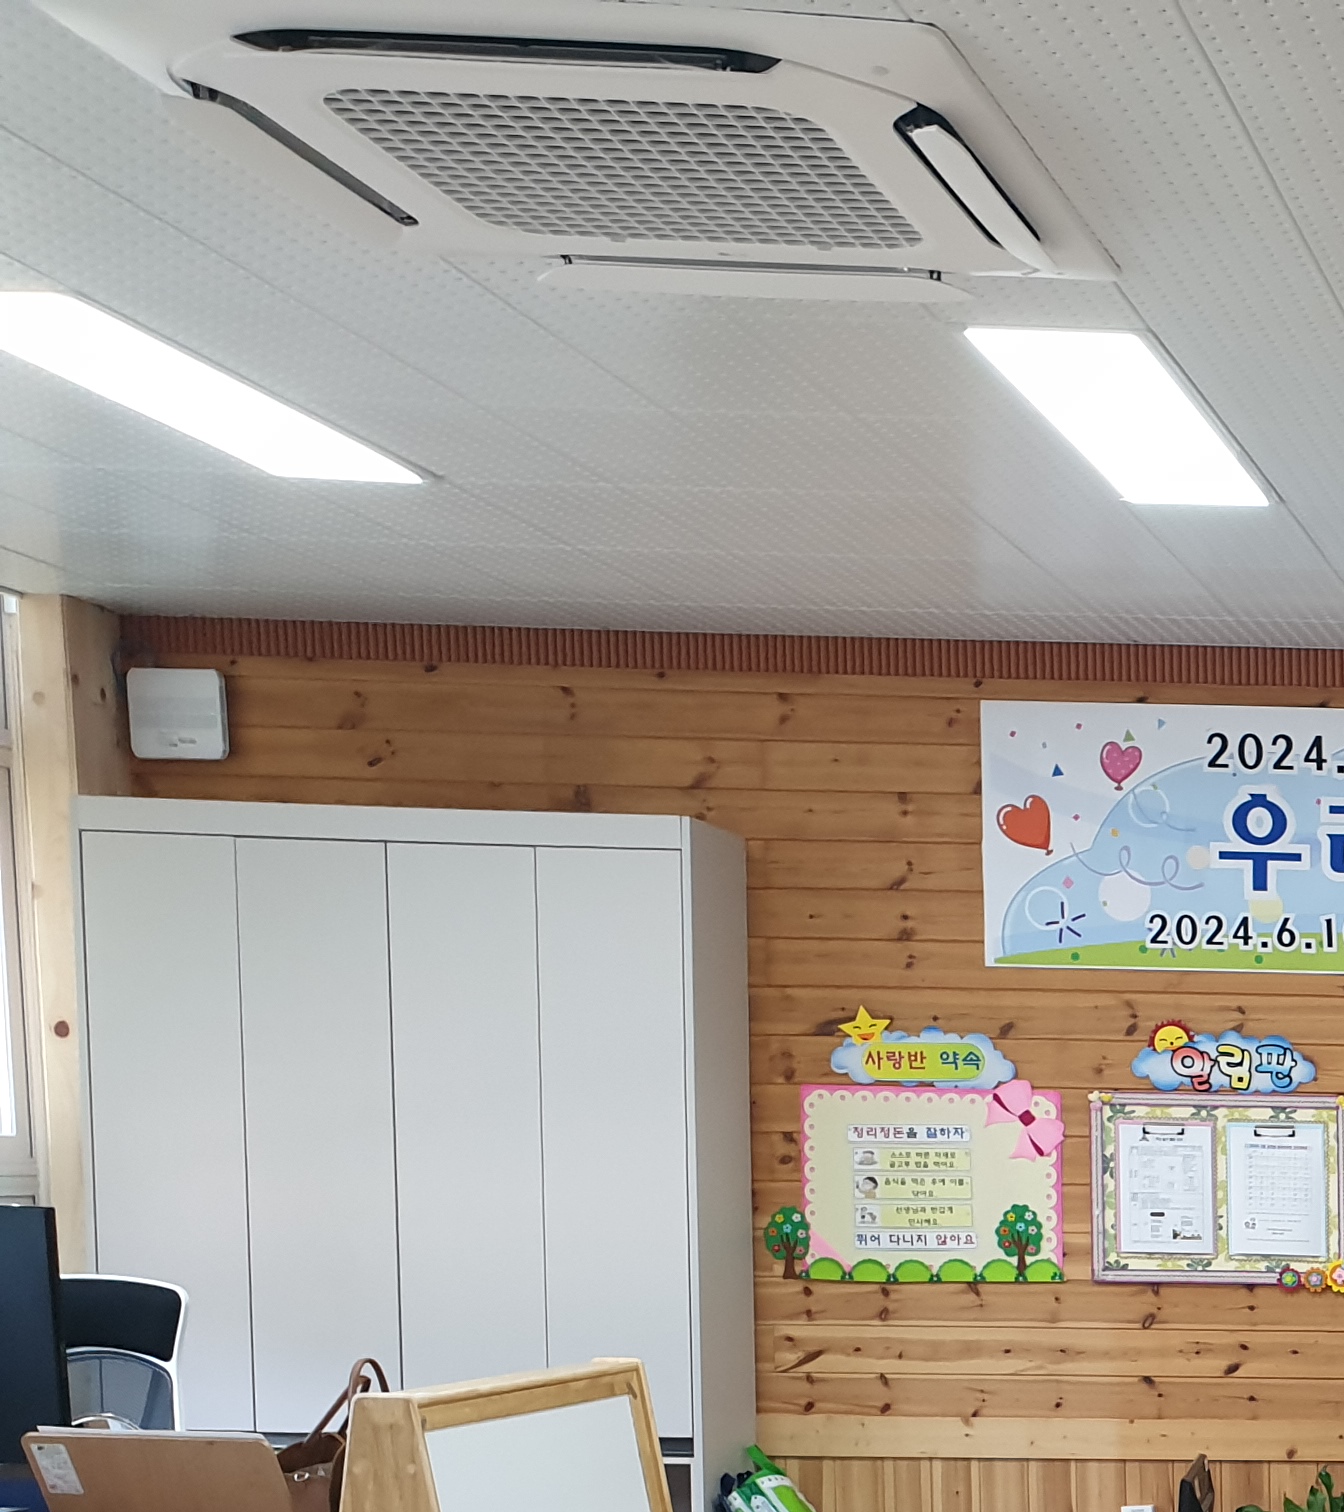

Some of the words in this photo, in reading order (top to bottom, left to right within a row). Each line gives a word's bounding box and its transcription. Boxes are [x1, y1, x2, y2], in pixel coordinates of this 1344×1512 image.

[864, 1050, 927, 1072] 사랑반
[939, 1051, 984, 1072] 약속
[1170, 1043, 1297, 1091] 알림판
[853, 1126, 918, 1139] 정리정돈을
[926, 1126, 966, 1139] 잘하자
[856, 1233, 881, 1246] 뛰어
[889, 1233, 928, 1246] 다니지
[935, 1233, 975, 1246] 않아요
